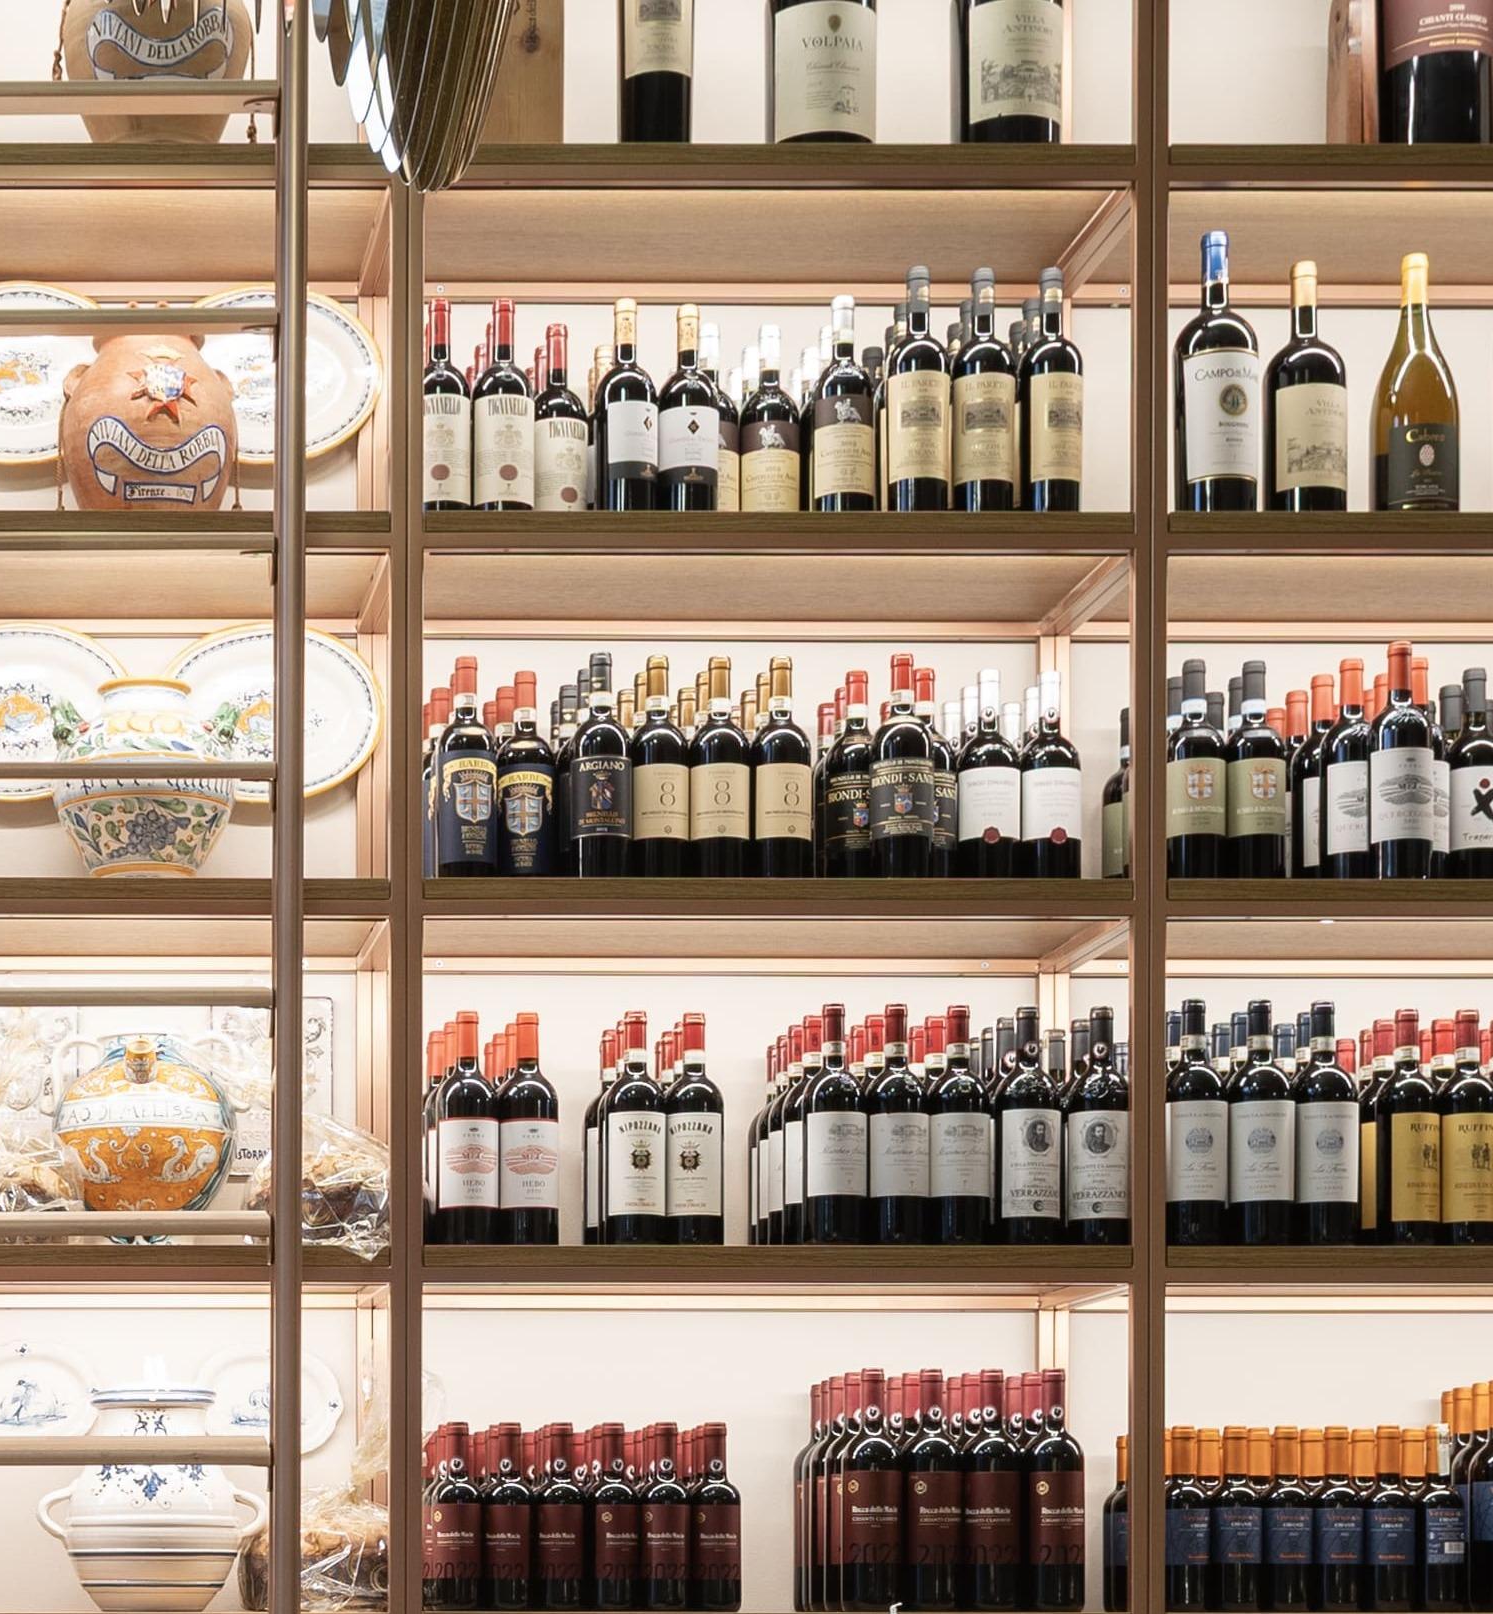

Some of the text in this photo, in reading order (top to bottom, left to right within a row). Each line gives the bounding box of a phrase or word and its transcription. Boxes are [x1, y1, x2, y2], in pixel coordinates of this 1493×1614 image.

[1419, 13, 1488, 26] CHIANTI CLASSICO
[147, 40, 187, 59] DELLA
[801, 37, 863, 52] VOLPAIA
[1195, 368, 1235, 381] CAMPO
[488, 396, 529, 417] TIGNANELLO
[549, 420, 587, 442] TIGNANELLO
[137, 450, 175, 470] DELLA
[579, 761, 625, 772] ARGIANO
[660, 781, 677, 807] 8
[715, 780, 731, 806] 8
[784, 781, 802, 807] 8
[619, 1121, 662, 1135] NIPOZZANO
[669, 1121, 713, 1135] NIPOZZANO
[462, 1179, 486, 1188] HEBO
[522, 1180, 546, 1188] HEBO
[1072, 1191, 1126, 1201] VERRAZZANO
